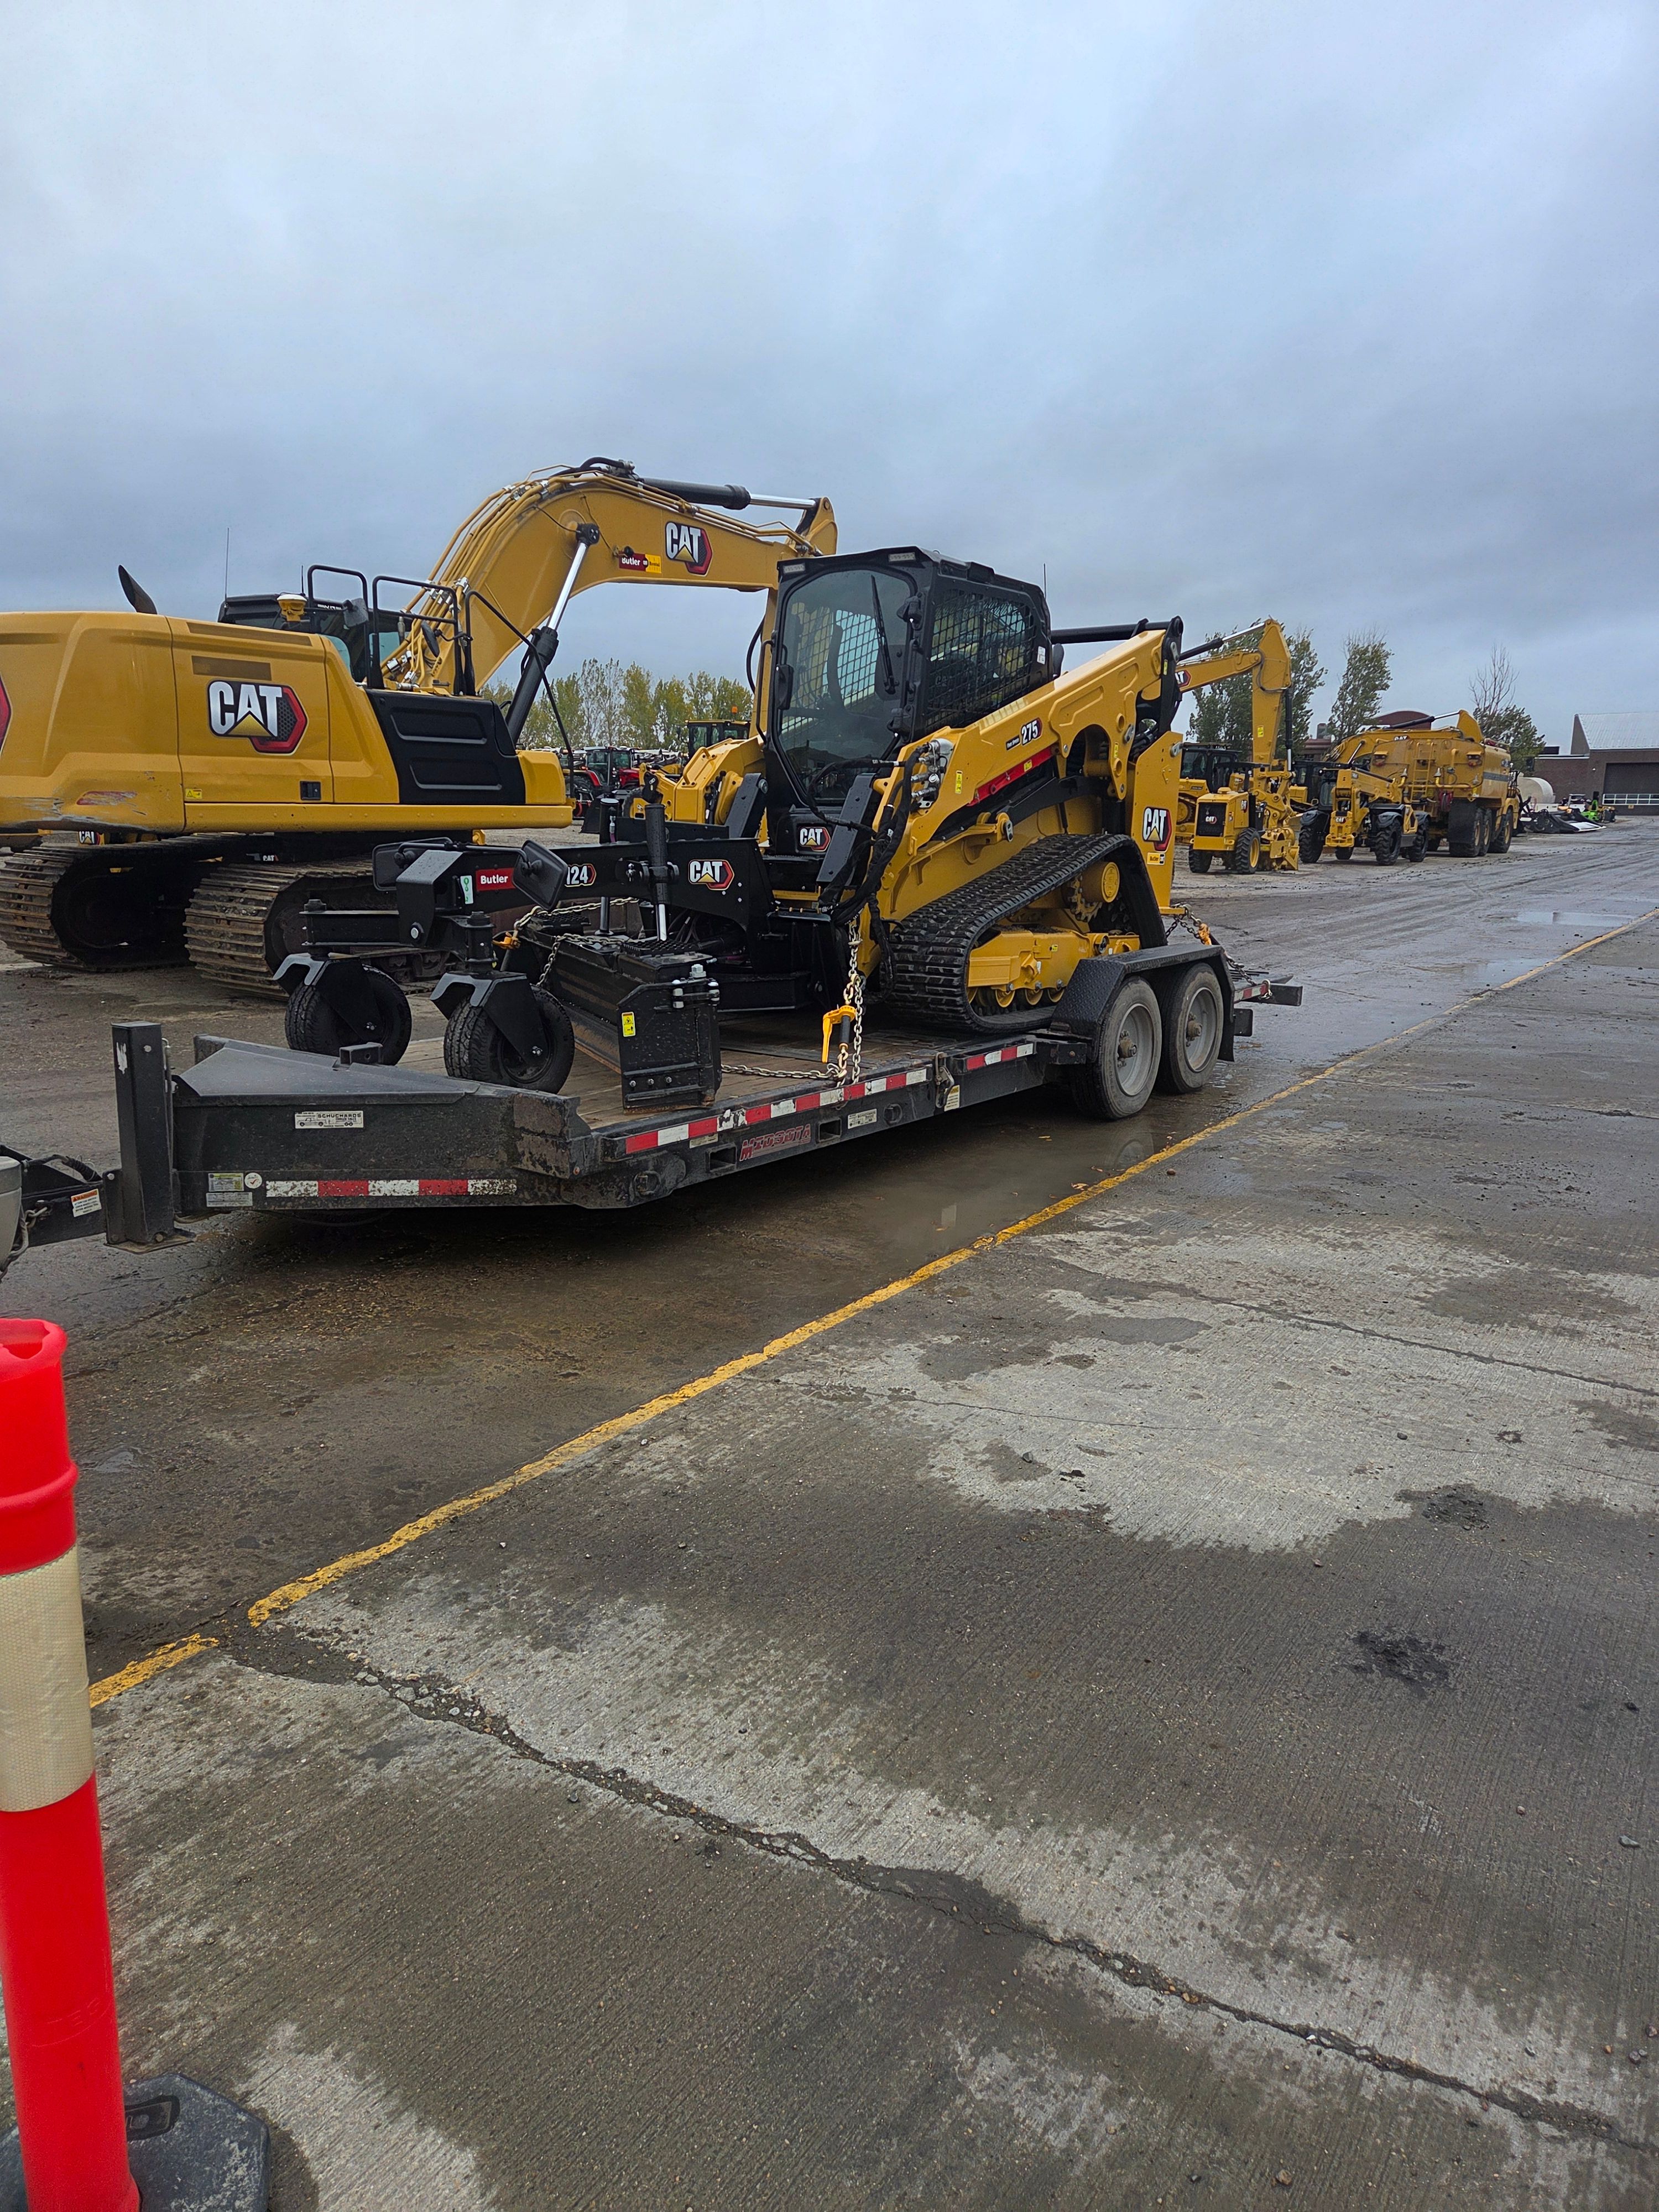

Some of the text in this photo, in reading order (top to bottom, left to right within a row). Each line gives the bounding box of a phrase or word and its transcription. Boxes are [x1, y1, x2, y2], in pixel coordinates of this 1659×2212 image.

[666, 522, 701, 563] CAT
[622, 557, 640, 566] Butler
[209, 681, 283, 737] CAT
[1021, 720, 1038, 744] 275
[1143, 807, 1167, 841] CAT
[800, 828, 823, 846] CAT
[481, 874, 508, 884] Butler
[690, 860, 723, 883] CAT
[739, 1124, 811, 1161] MIDSOTA
